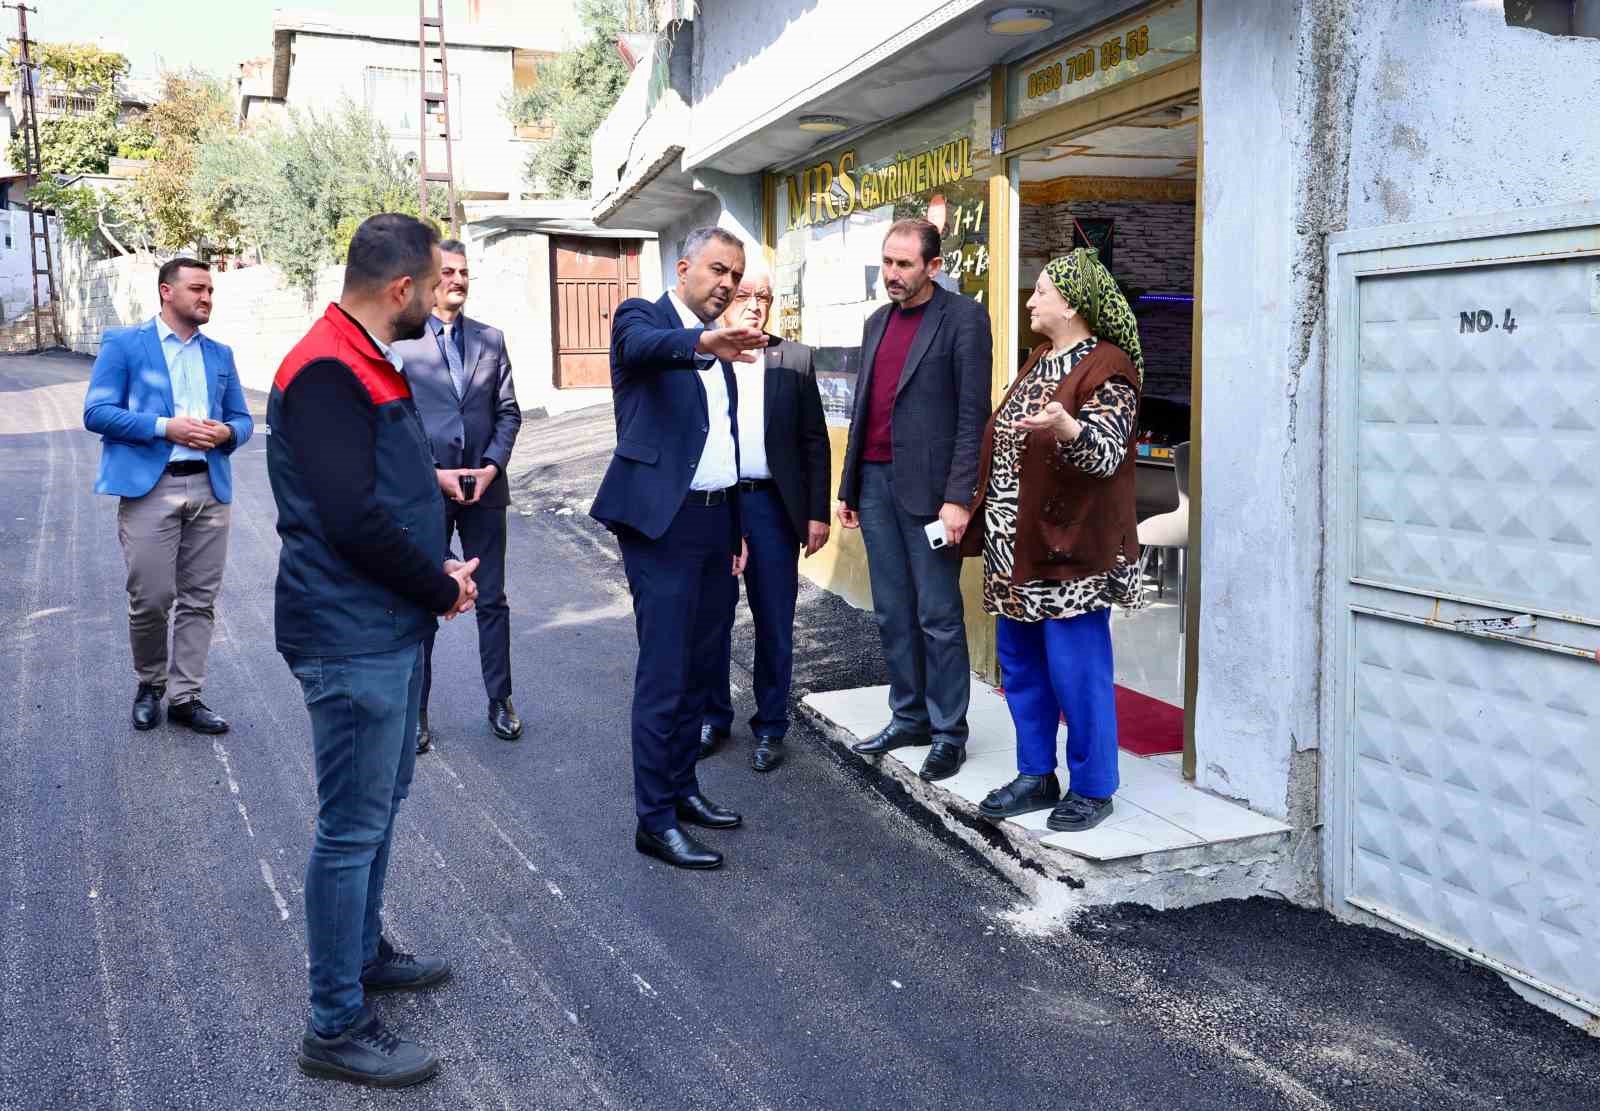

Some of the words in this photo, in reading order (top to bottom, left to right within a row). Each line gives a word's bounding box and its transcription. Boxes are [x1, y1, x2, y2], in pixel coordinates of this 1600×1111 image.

[1066, 48, 1095, 84] 700
[786, 151, 856, 230] MRS
[860, 137, 973, 208] GAYRİMENKUL
[952, 200, 984, 236] 1+1
